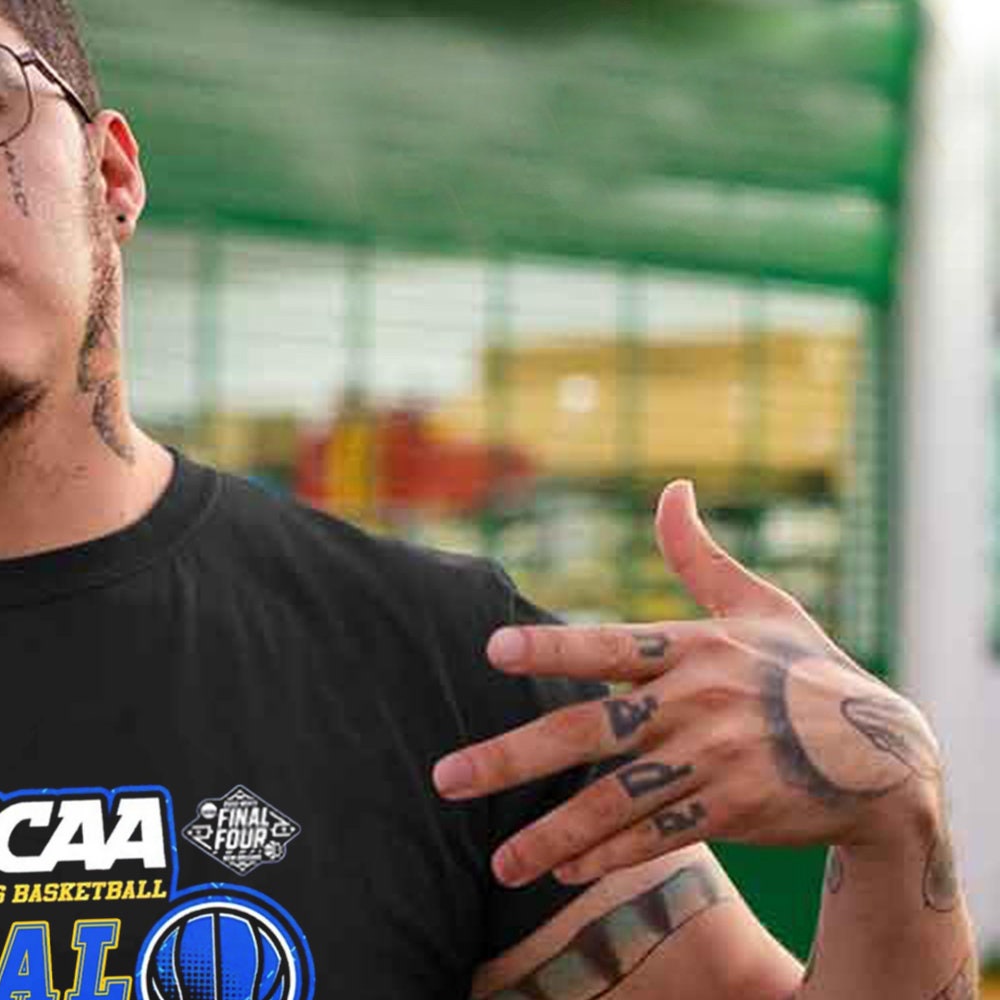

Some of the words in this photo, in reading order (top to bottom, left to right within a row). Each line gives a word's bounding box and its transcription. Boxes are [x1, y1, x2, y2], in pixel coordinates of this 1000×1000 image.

[217, 806, 270, 828] FINAL
[214, 827, 268, 850] FOUR
[11, 879, 167, 904] BASKETBALL
